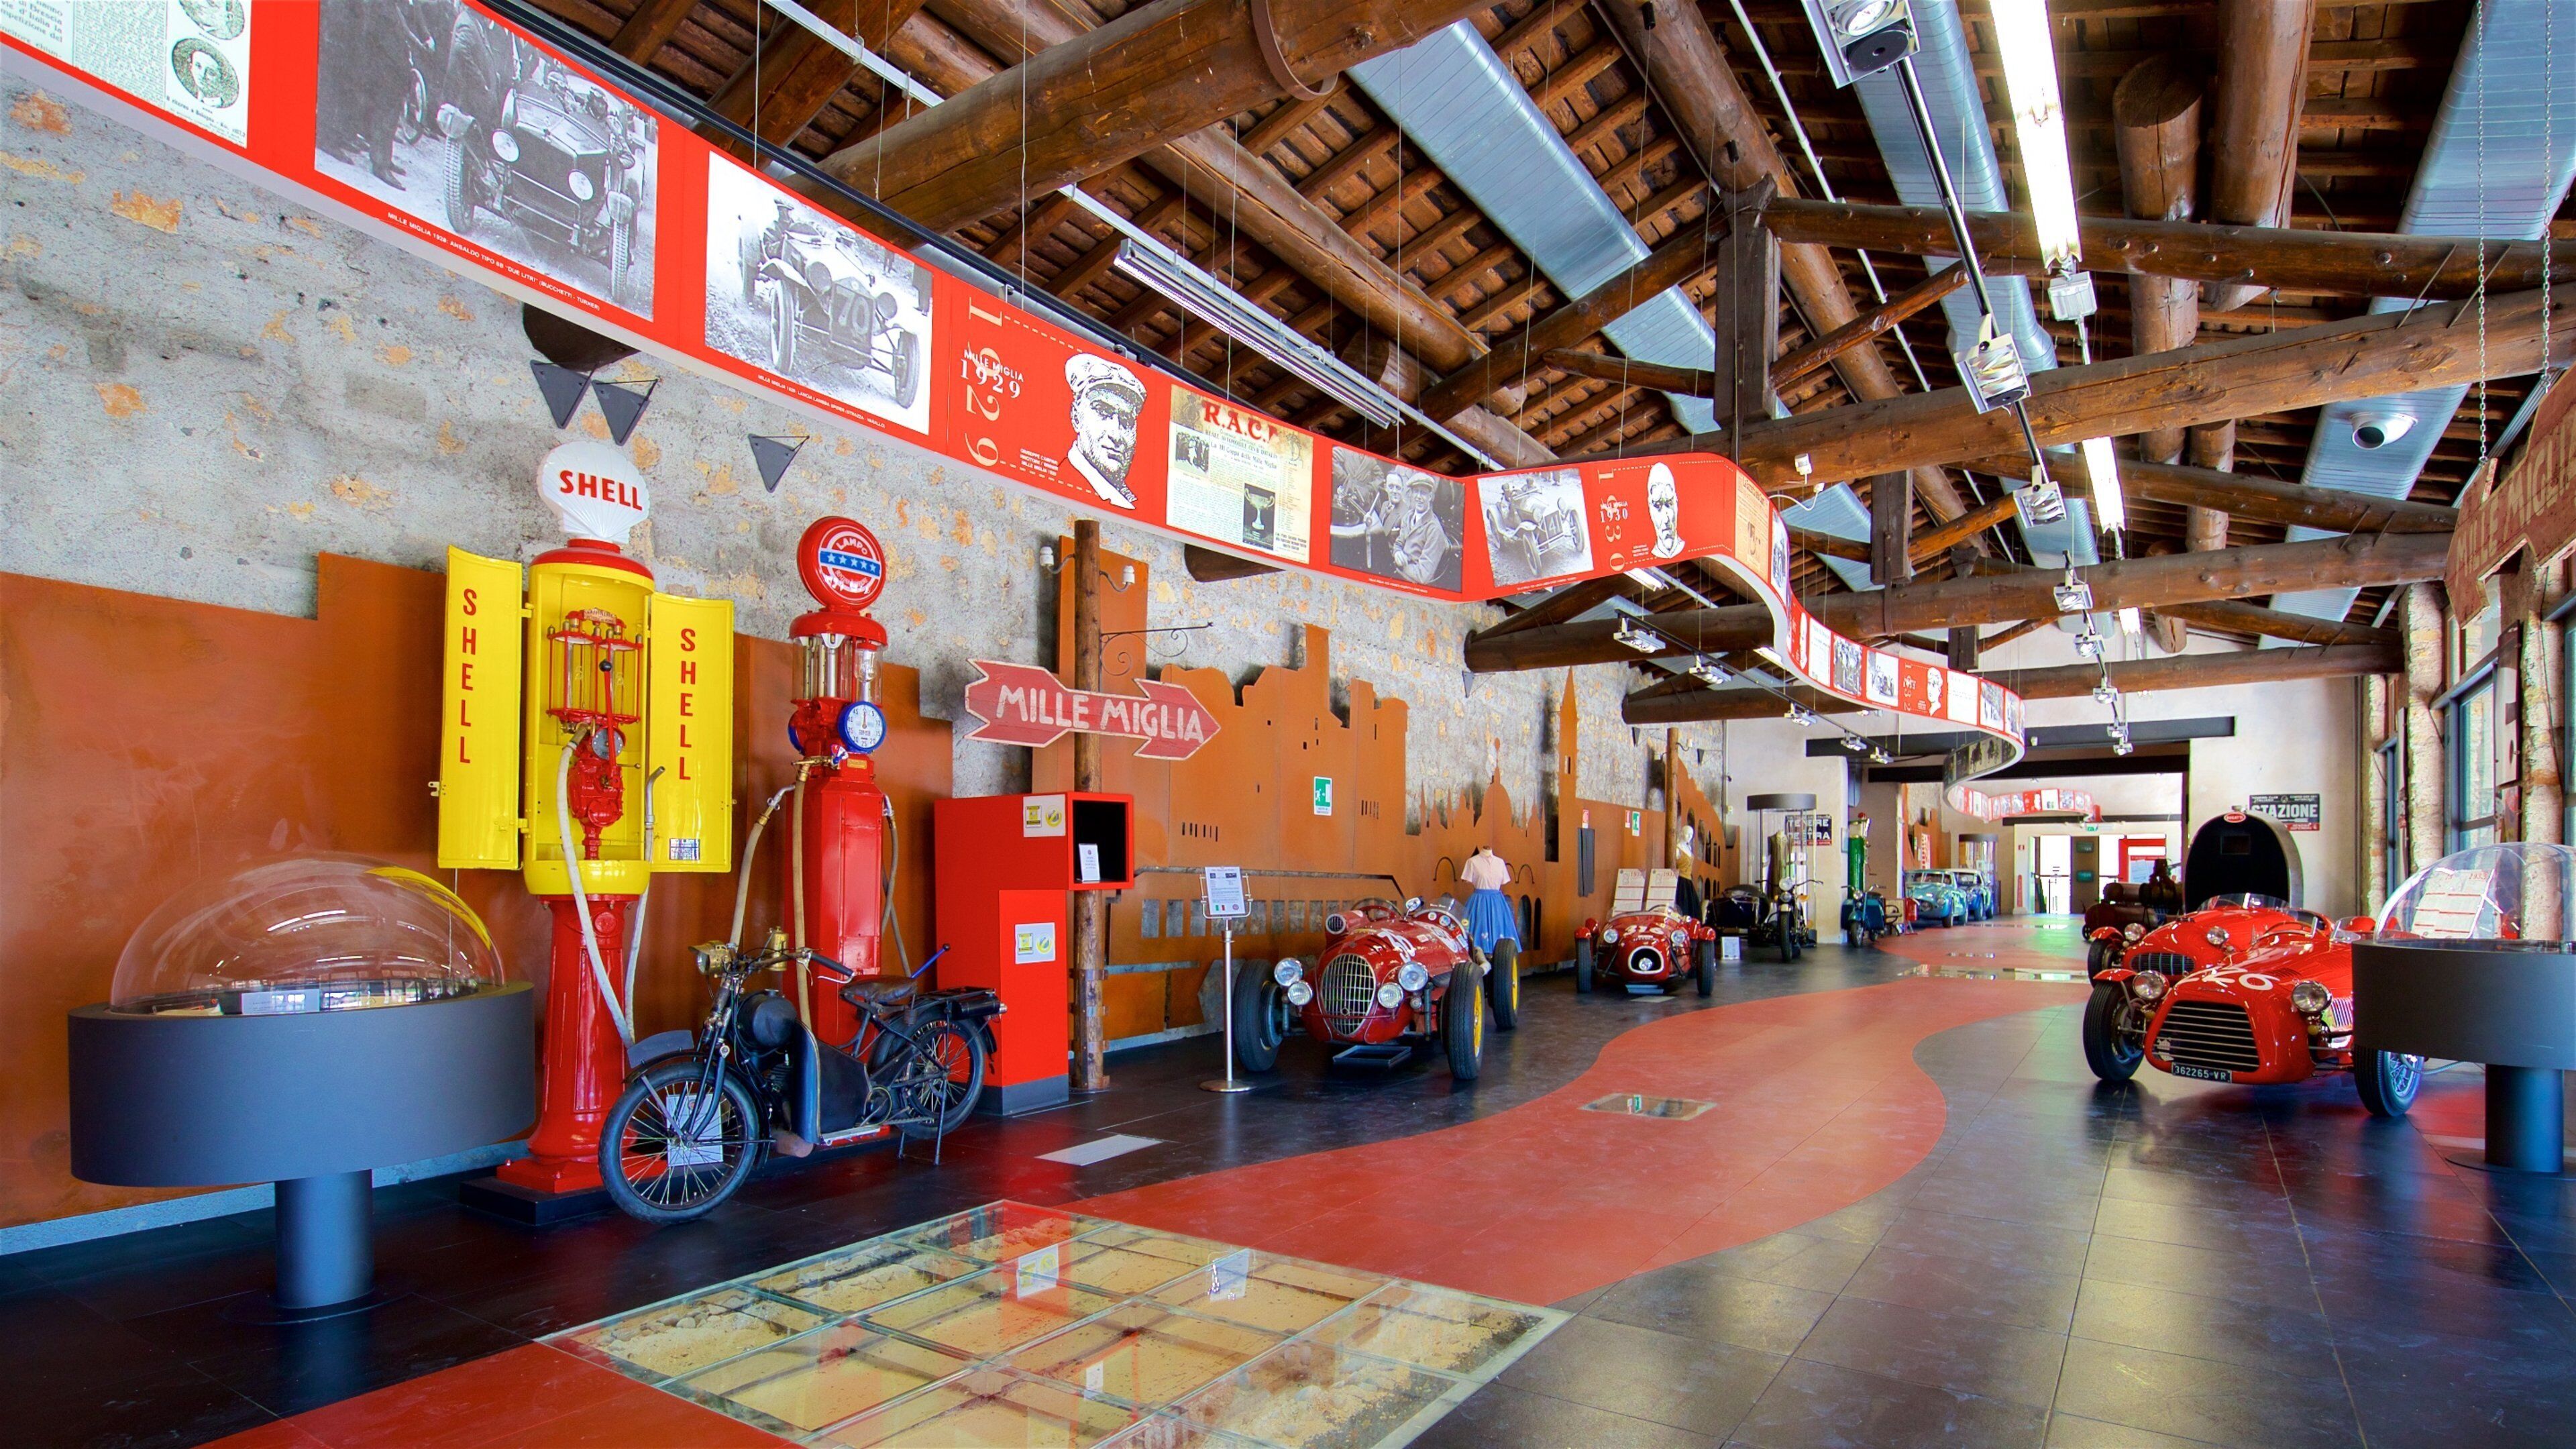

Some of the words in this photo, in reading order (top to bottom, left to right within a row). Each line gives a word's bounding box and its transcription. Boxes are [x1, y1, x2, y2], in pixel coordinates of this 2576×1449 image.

[30, 3, 62, 25] Brescia
[50, 32, 62, 43] del
[388, 212, 408, 225] MILLE
[409, 222, 431, 236] MIGLIA
[450, 241, 480, 258] ANSALDO
[481, 255, 495, 264] TIPO
[576, 297, 600, 311] TURNER)
[961, 358, 1020, 398] 1929
[963, 349, 989, 368] MILLE
[992, 362, 1024, 382] MIGLIA
[559, 470, 643, 511] SHELL
[1599, 508, 1629, 523] 1930
[836, 537, 868, 555] LAMPO
[2455, 496, 2499, 588] MILLE
[460, 588, 477, 763] SHELL
[680, 628, 696, 780] SHELL
[996, 684, 1089, 729] MILLE
[1100, 699, 1204, 743] MIGLIA
[1787, 819, 1829, 827] TEERE
[1787, 831, 1830, 840] ETRA
[2175, 1065, 2209, 1078] 362265
